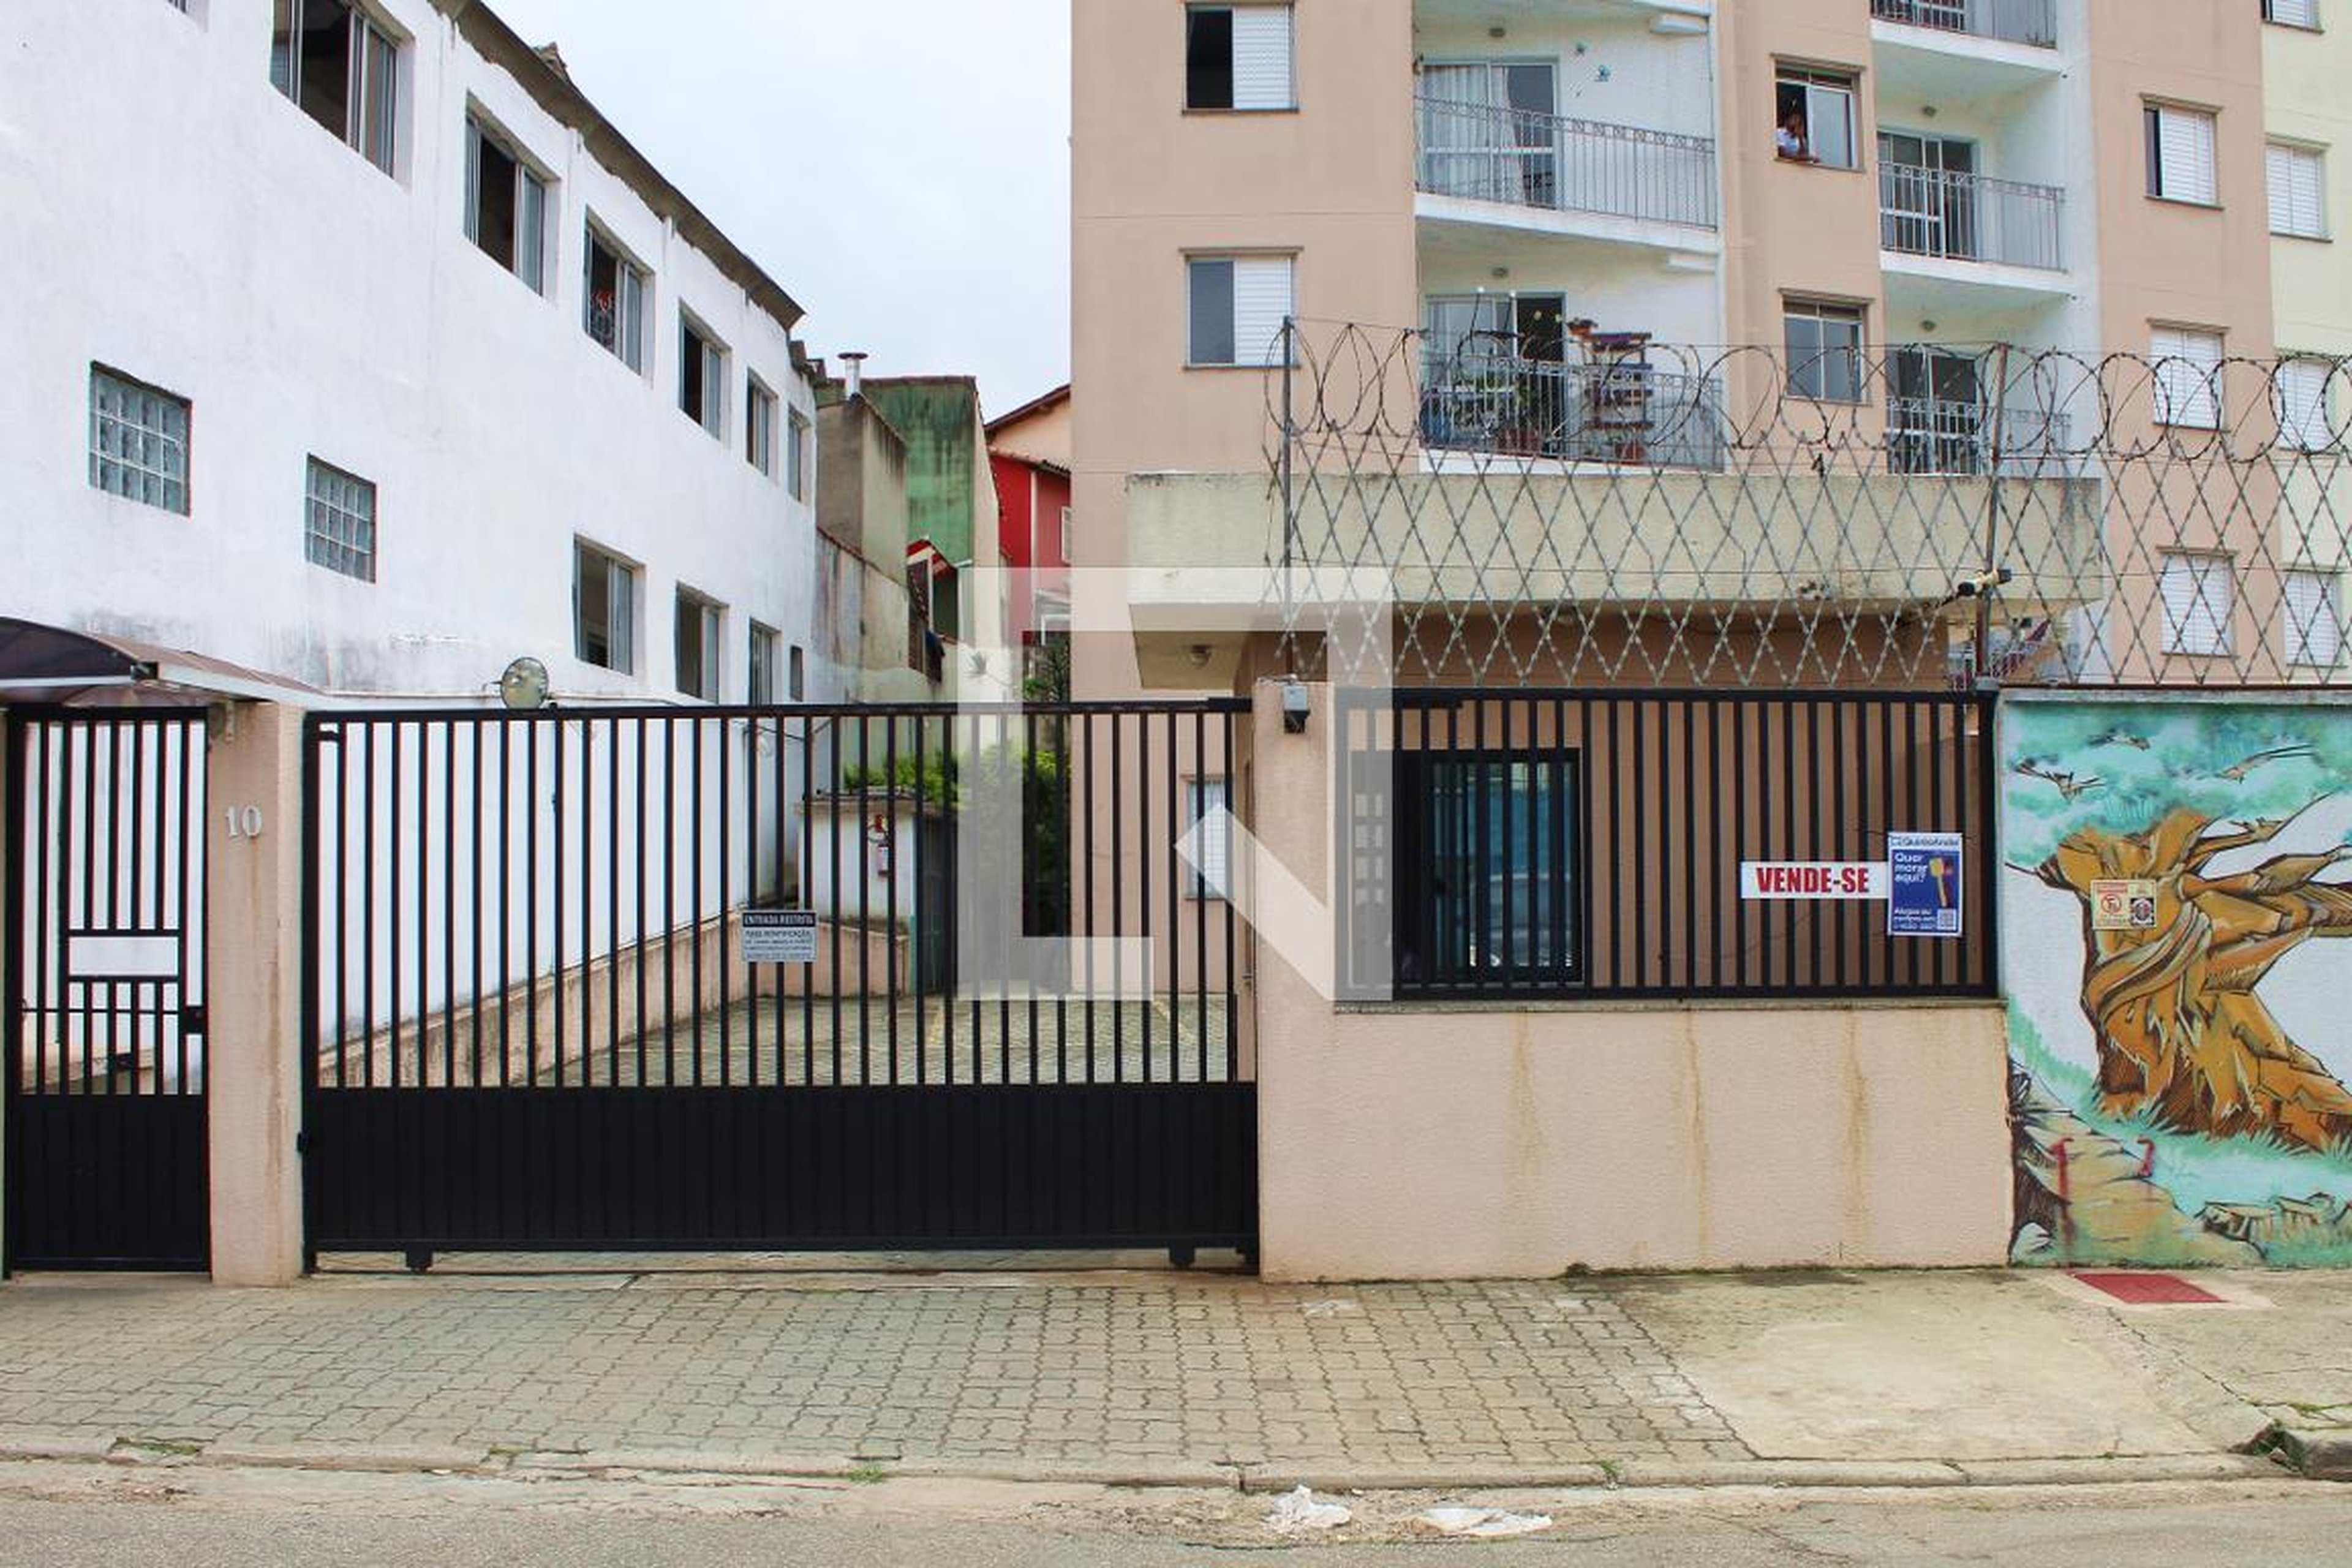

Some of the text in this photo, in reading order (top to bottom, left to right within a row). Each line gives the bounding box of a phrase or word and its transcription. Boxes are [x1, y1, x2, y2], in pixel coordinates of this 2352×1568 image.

[227, 805, 262, 837] 10
[1756, 867, 1869, 892] VENDE-SE
[1894, 873, 1926, 885] aqui?
